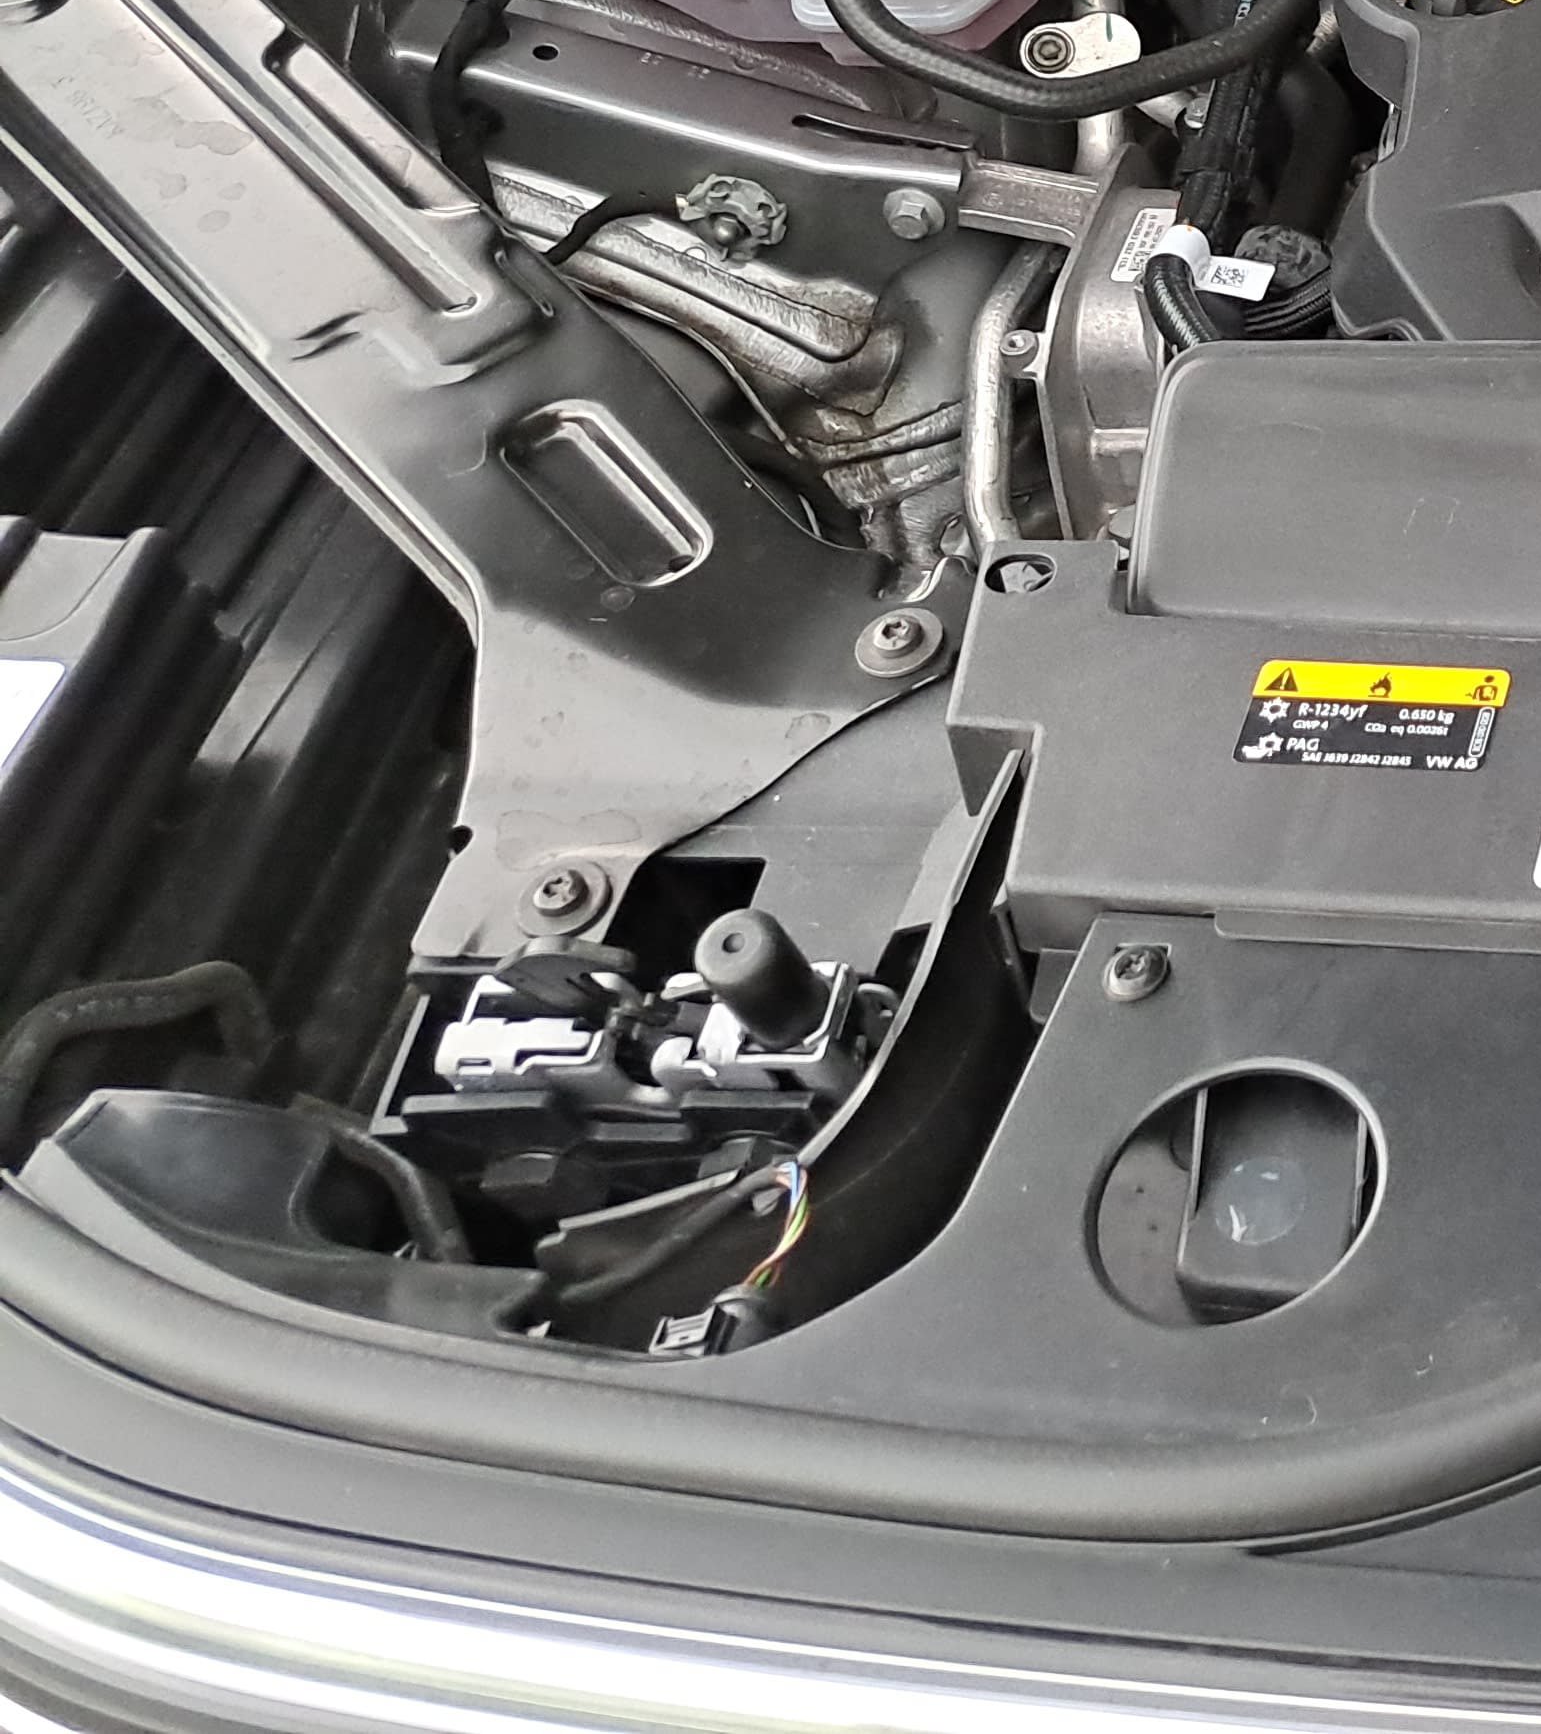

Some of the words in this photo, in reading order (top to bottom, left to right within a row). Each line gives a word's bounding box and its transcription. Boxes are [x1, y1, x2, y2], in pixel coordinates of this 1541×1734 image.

[1298, 703, 1368, 721] R-1234yf
[1399, 709, 1436, 721] 0.650
[1438, 709, 1455, 725] kg
[1321, 721, 1328, 730] 4
[1390, 725, 1404, 736] eq
[1286, 738, 1320, 751] PAG
[1301, 752, 1322, 762] SAE
[1426, 756, 1453, 768] VW
[1454, 756, 1478, 769] AG
